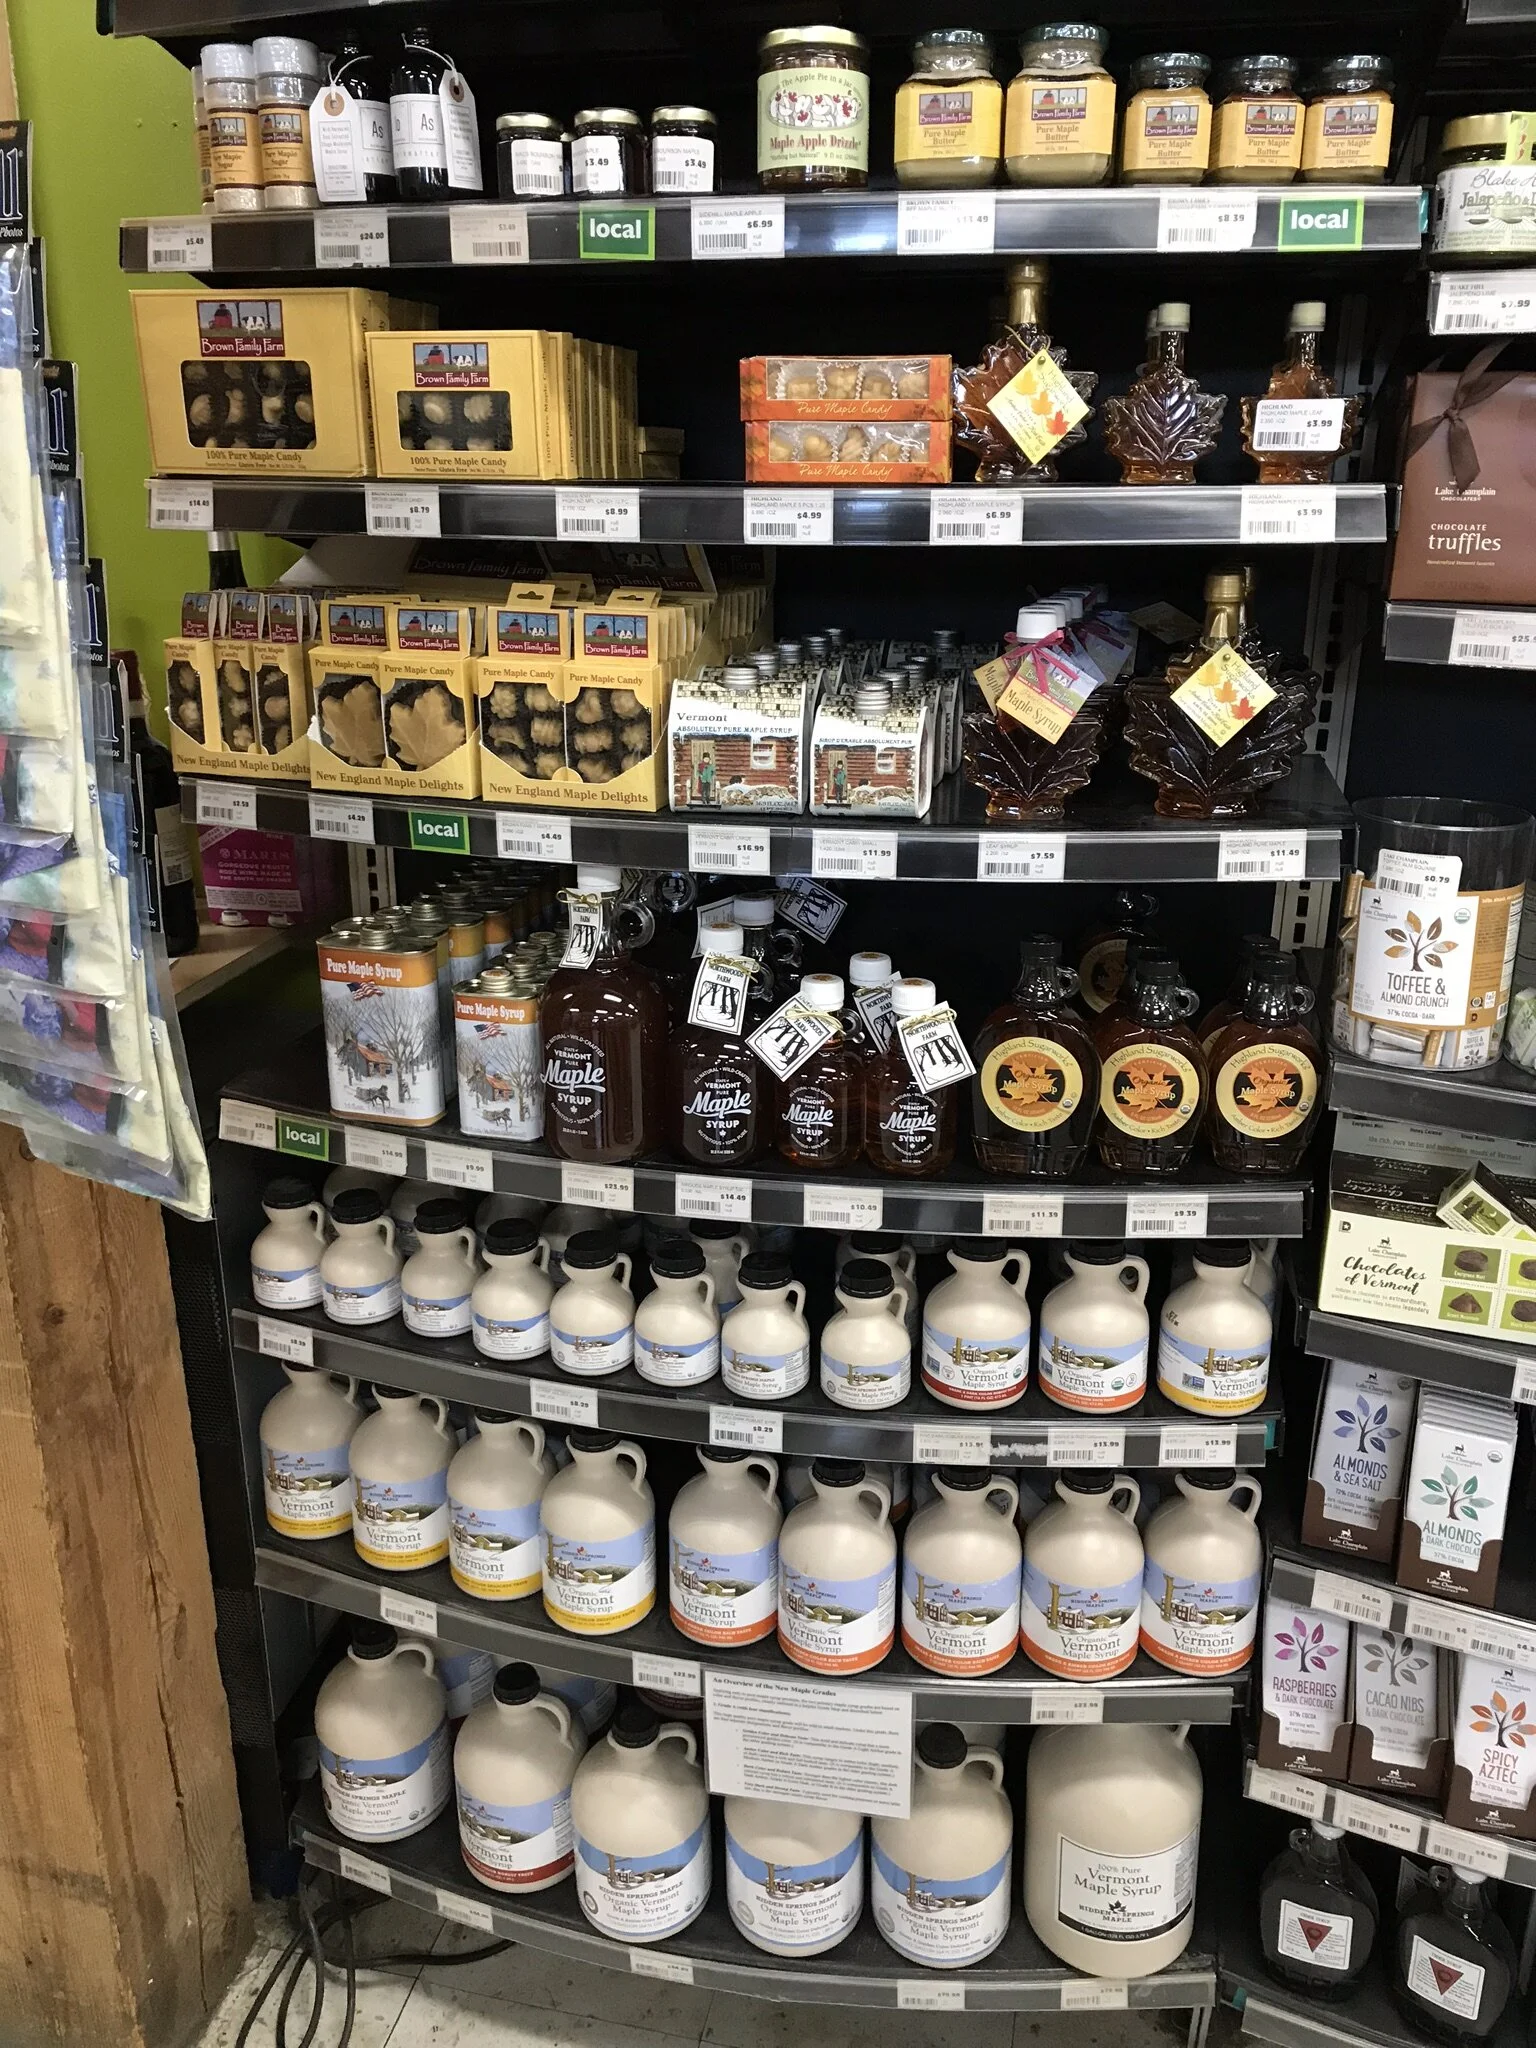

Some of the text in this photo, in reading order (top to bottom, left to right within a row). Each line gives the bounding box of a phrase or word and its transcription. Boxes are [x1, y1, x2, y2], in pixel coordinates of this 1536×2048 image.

[780, 78, 793, 88] The
[795, 73, 815, 83] Apple
[818, 73, 828, 81] Pie
[830, 75, 837, 83] in
[843, 79, 852, 88] Jar
[420, 114, 434, 131] As
[1033, 109, 1086, 120] Brown Family Farm
[372, 121, 384, 138] As
[1037, 124, 1079, 134] Pure Maple
[1046, 132, 1069, 141] Butter
[770, 134, 860, 154] Maple Apple Drizzle
[584, 158, 609, 168] $3.49
[685, 158, 707, 169] $3.49
[1470, 168, 1520, 189] Blake
[1460, 190, 1521, 212] Jalapeño
[747, 220, 773, 228] $6.99
[1291, 209, 1348, 230] local
[360, 232, 384, 241] $24.00
[590, 218, 642, 240] local
[201, 337, 284, 356] Brown Family Farm
[416, 372, 489, 387] Brown Family Farm
[797, 401, 893, 416] Pure Maple Candy
[1307, 419, 1333, 428] $3.99
[206, 450, 302, 463] 100% Pure Maple Candy
[410, 457, 507, 467] 100% Pure Maple Candy
[797, 512, 822, 520] $4.99
[986, 512, 1011, 520] $6.99
[1428, 533, 1501, 554] truffles
[499, 640, 560, 653] Brown Family Farm
[483, 668, 555, 679] Pure Maple Candy
[677, 712, 728, 722] Vermont
[177, 755, 310, 775] New England Maple Delights
[316, 771, 464, 791] New England Maple Delights
[489, 783, 648, 804] New England Maple Delights
[418, 819, 459, 838] local
[1030, 852, 1055, 860] $7.59
[1425, 875, 1450, 884] $0.79
[327, 958, 402, 981] Pure Maple Syrup
[1387, 972, 1446, 995] TOFFEE &
[1380, 991, 1449, 1008] ALMOND CRUNCH
[457, 1000, 525, 1020] Pure Maple Syrup
[554, 1050, 591, 1061] VERMONT
[992, 1039, 1072, 1068] Highland Sugarworks
[540, 1059, 606, 1093] Maple
[705, 1081, 741, 1089] VERMONT
[1004, 1080, 1057, 1094] Maple Syrup
[558, 1093, 592, 1106] SYRUP
[683, 1090, 751, 1119] Maple
[796, 1097, 825, 1106] VERMONT
[782, 1103, 834, 1126] Maple
[706, 1120, 740, 1128] SYRUP
[796, 1127, 823, 1136] SYRUP
[286, 1126, 320, 1146] local
[1343, 1256, 1427, 1281] Chocolates
[1344, 1273, 1420, 1295] of Vermont
[961, 1369, 1008, 1382] Vermont
[1057, 1370, 1104, 1388] Vermont
[1212, 1378, 1258, 1391] Vermont
[1333, 1454, 1388, 1480] ALMONDS
[1334, 1471, 1382, 1491] & SEA SALT
[280, 1498, 334, 1511] Vermont
[366, 1526, 422, 1542] Vermont
[1422, 1519, 1482, 1546] ALMONDS
[724, 1678, 751, 1687] Overview
[791, 1686, 811, 1696] Maple
[813, 1689, 836, 1697] Grades
[1273, 1676, 1337, 1698] RASPBERRIES
[1275, 1693, 1334, 1710] & DARK CHOCOLATE
[1365, 1689, 1424, 1713] CACAO NIBS
[1483, 1748, 1518, 1766] SPICY
[1479, 1764, 1518, 1785] AZTEC
[1088, 1867, 1150, 1885] Vermont
[1074, 1873, 1162, 1898] Maple Syrup
[770, 1912, 830, 1926] Maple Syrup
[896, 1904, 924, 1922] HIDDEN
[959, 1911, 984, 1922] MAPLE
[900, 1912, 980, 1932] Organic Vermont
[910, 1927, 970, 1941] Maple Syrup
